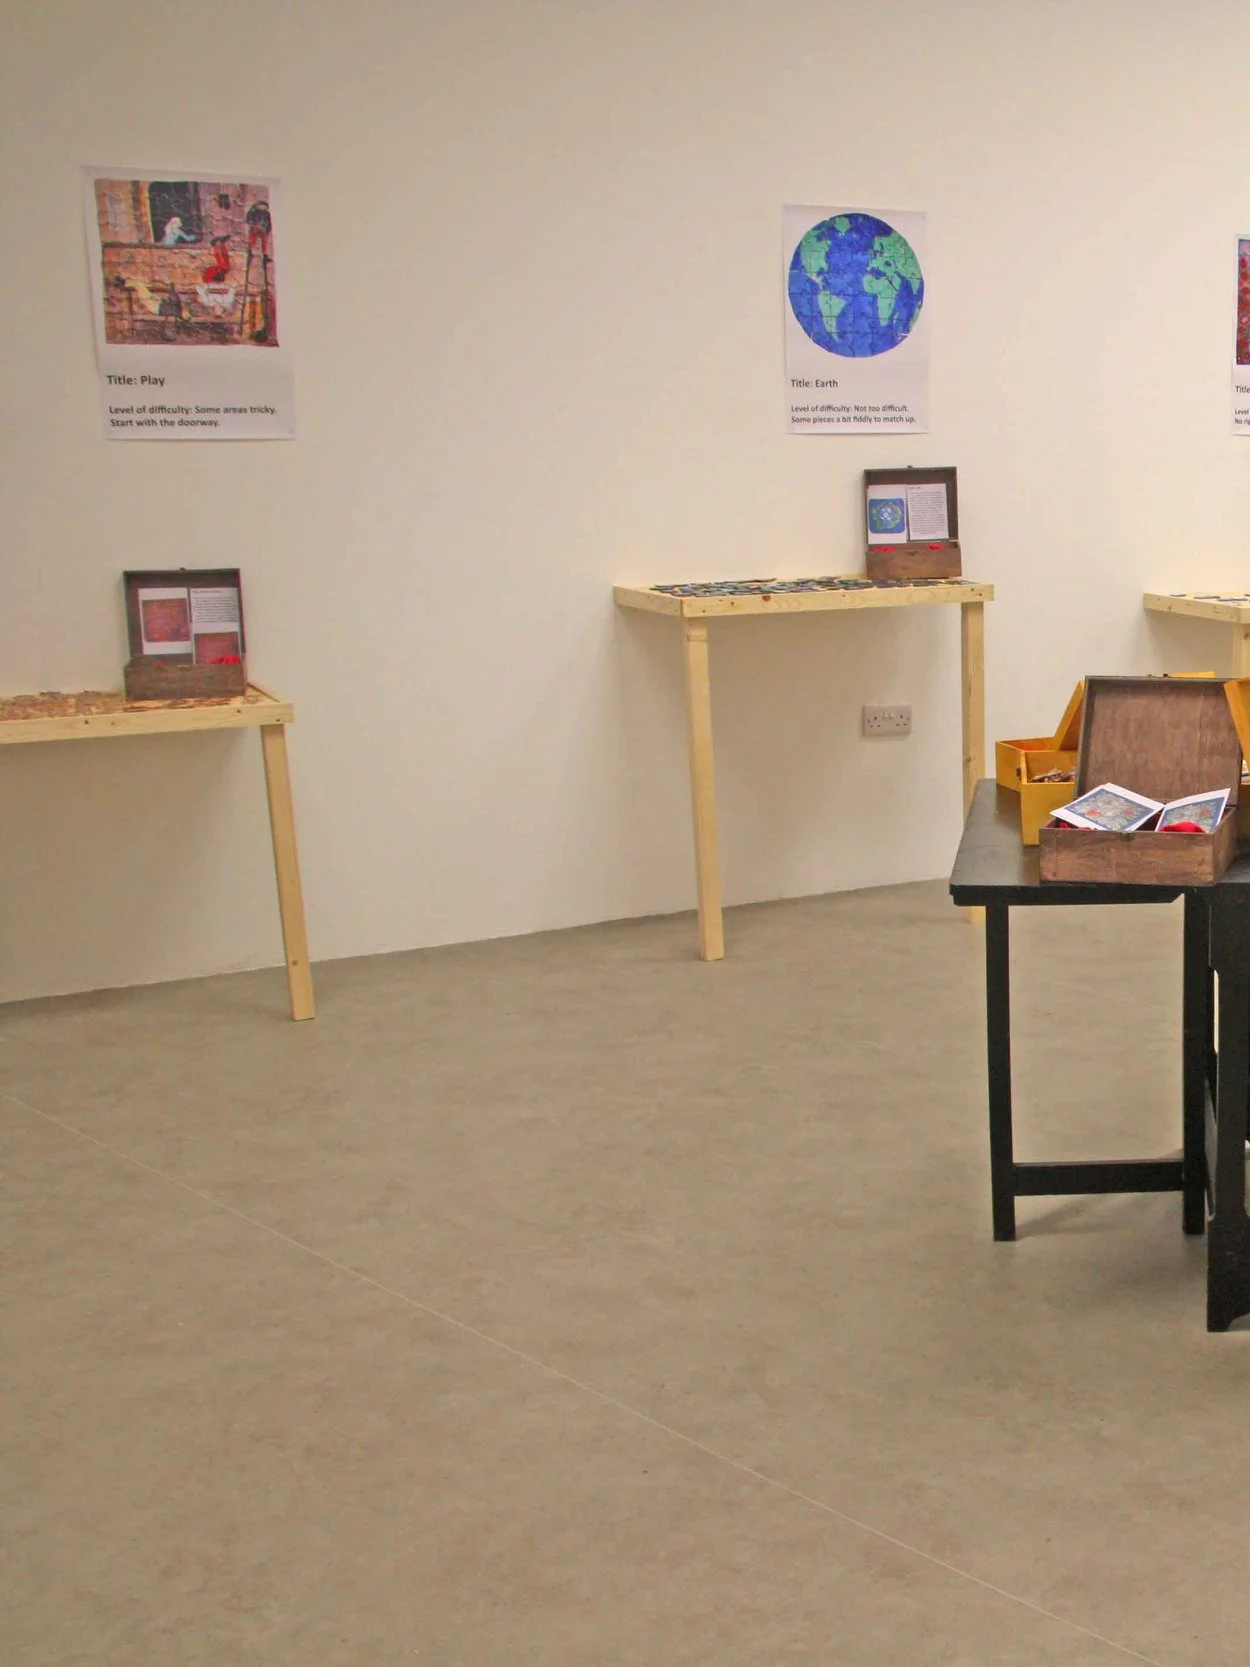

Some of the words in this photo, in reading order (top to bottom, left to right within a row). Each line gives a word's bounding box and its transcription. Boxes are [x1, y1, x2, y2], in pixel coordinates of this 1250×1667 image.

[106, 375, 137, 385] Title:
[140, 375, 165, 387] Play
[791, 379, 813, 388] Title:
[815, 379, 838, 388] Earth
[109, 405, 134, 414] Level
[136, 405, 146, 414] of
[149, 405, 193, 415] difficulty:
[194, 406, 221, 414] Some
[249, 405, 277, 415] tricky.
[820, 405, 852, 413] difficulty:
[110, 419, 133, 427] Start
[136, 418, 157, 427] with
[160, 418, 175, 427] the
[177, 418, 220, 428] doorway.
[853, 416, 872, 424] fiddly
